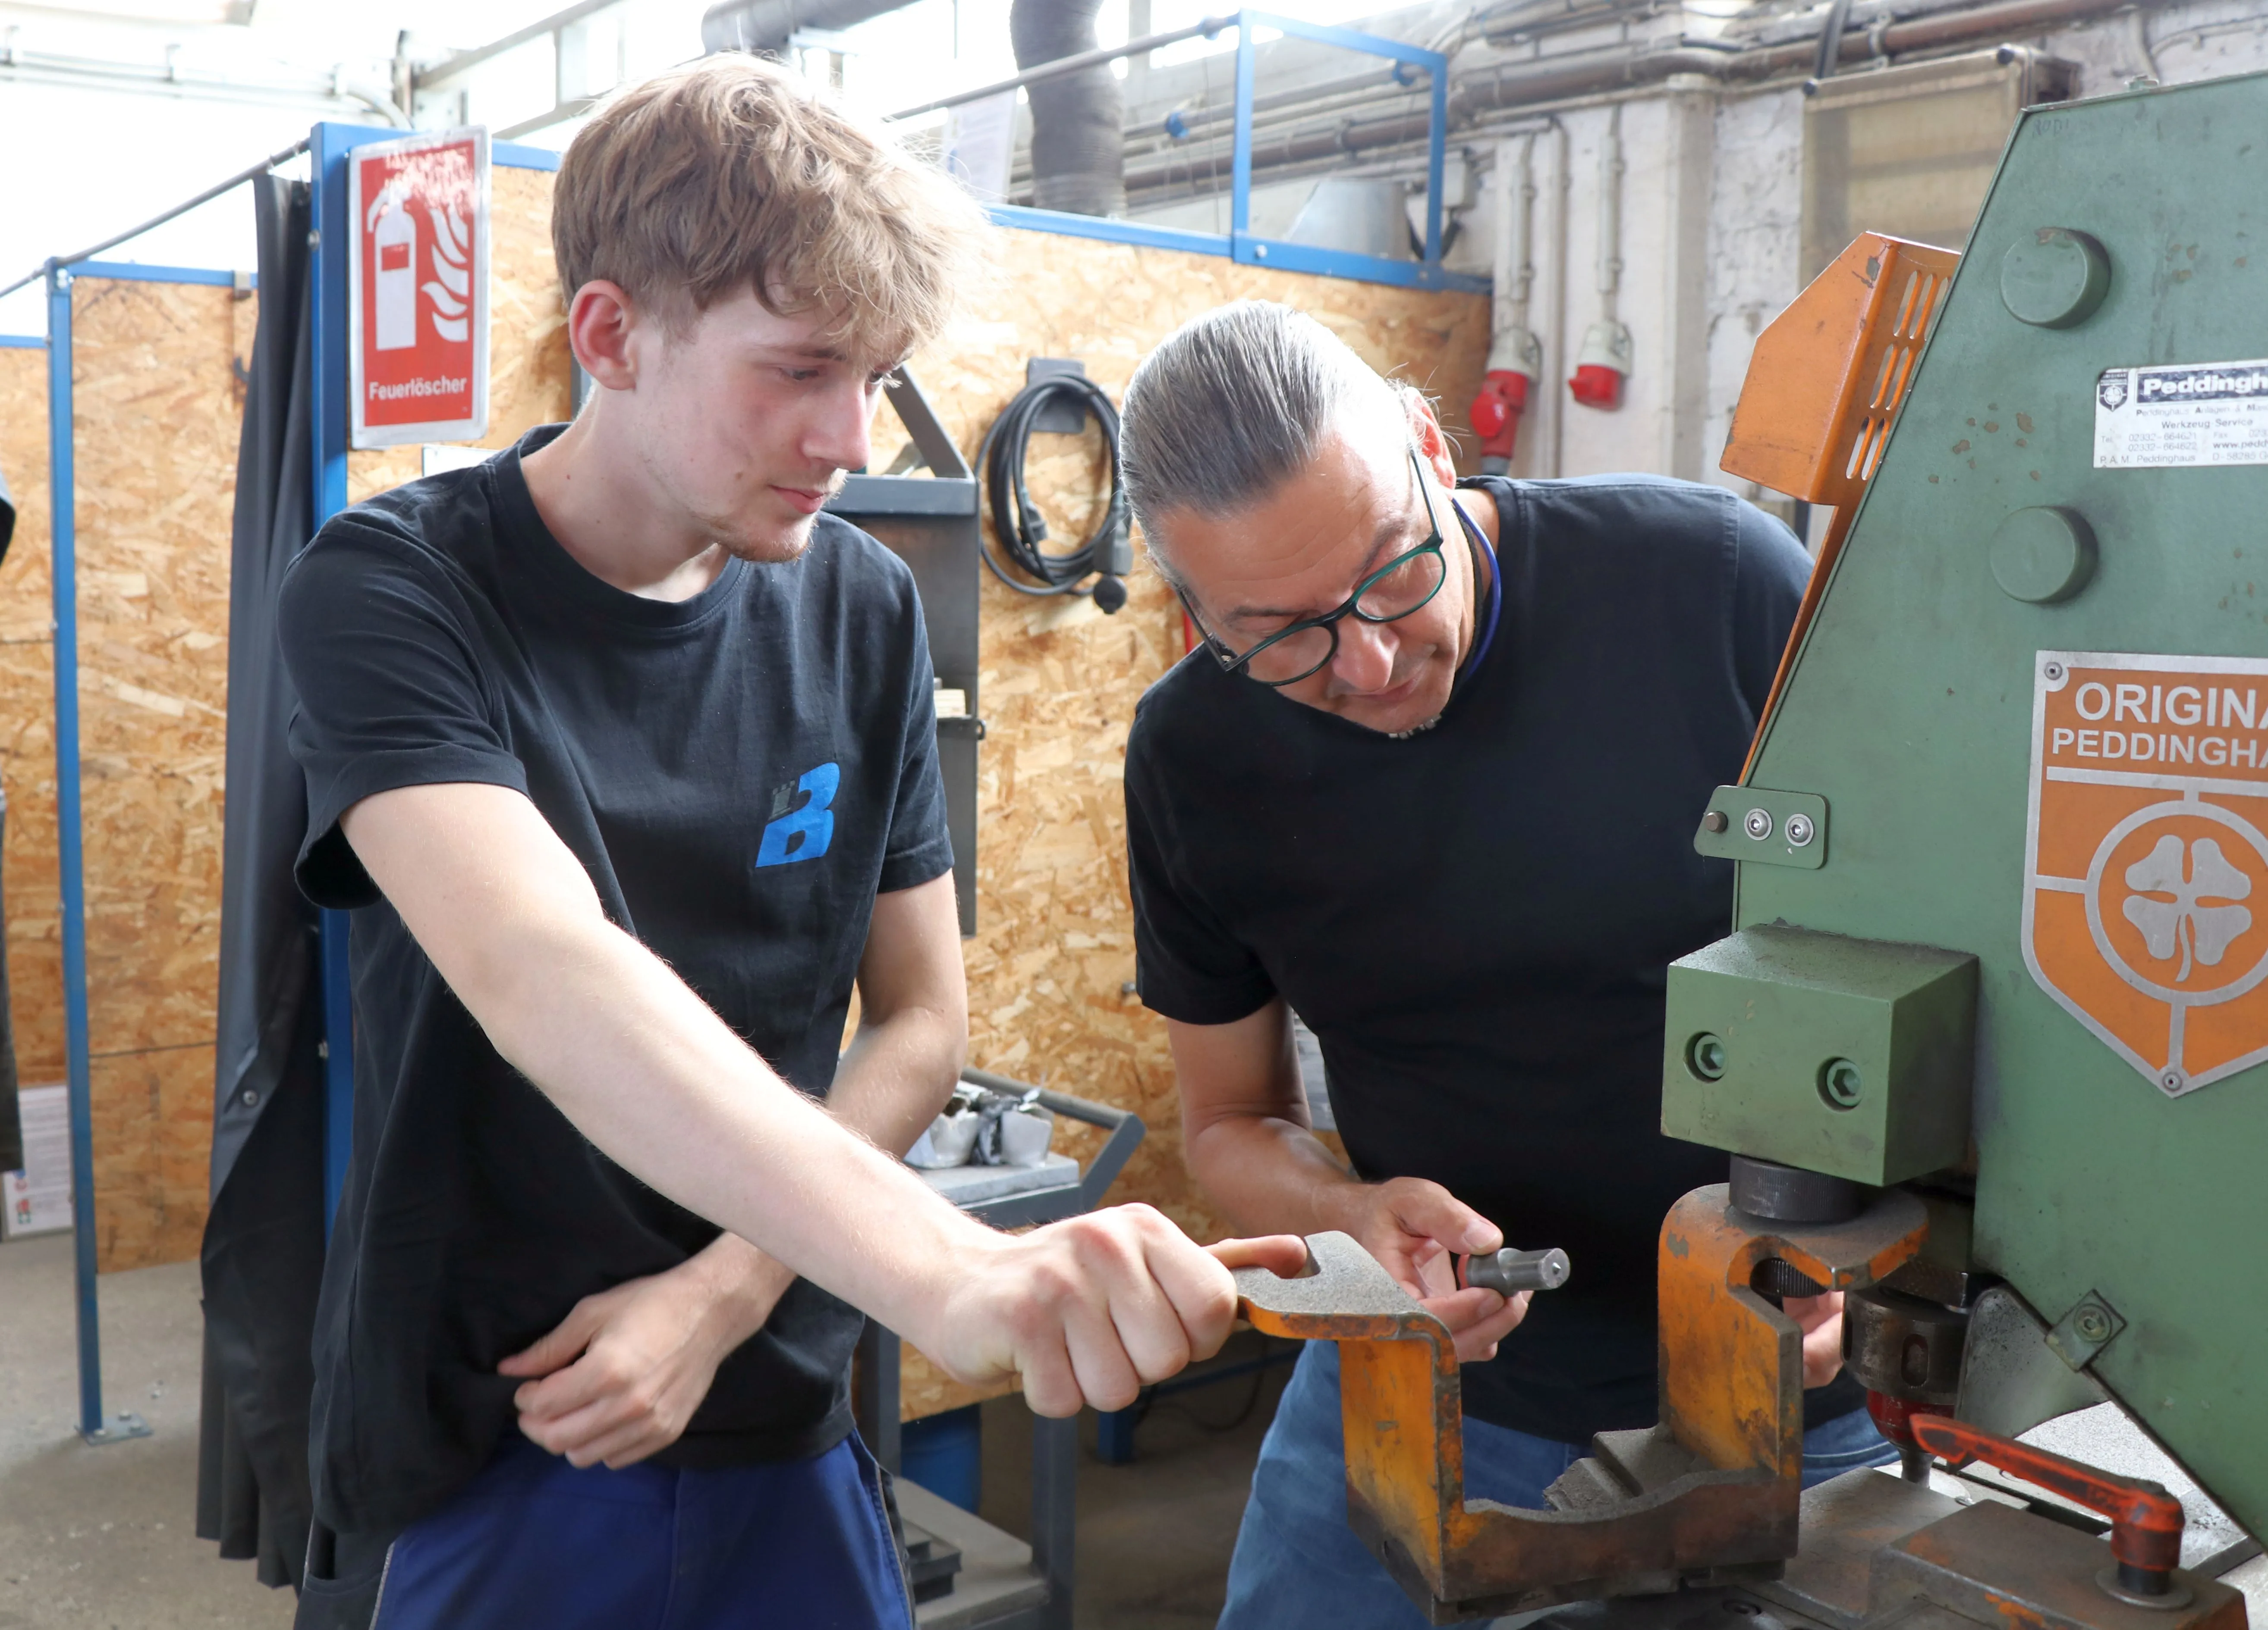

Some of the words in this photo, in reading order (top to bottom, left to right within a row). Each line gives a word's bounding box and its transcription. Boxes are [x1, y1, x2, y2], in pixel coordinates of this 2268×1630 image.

[369, 375, 467, 401] Feuerlöscher
[2143, 372, 2268, 396] Peddingh
[2137, 454, 2196, 465] Peddinghaus
